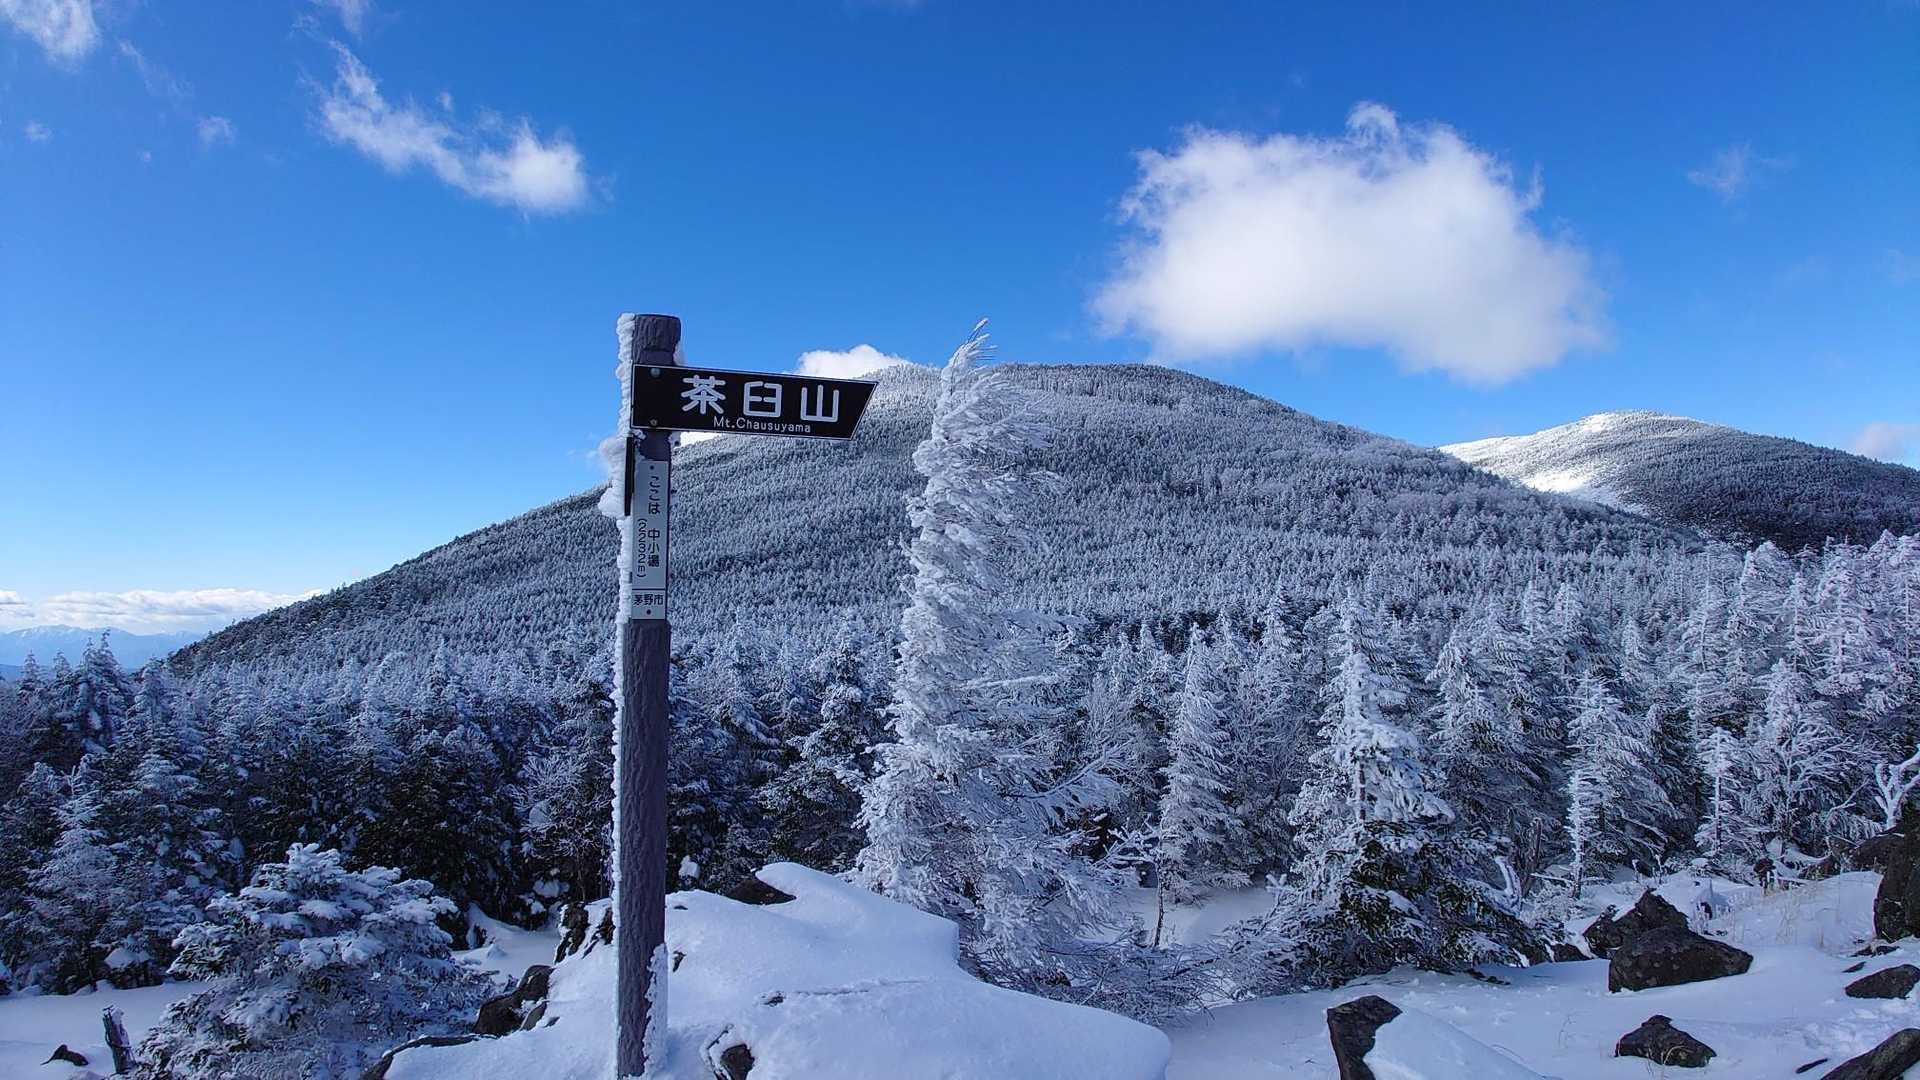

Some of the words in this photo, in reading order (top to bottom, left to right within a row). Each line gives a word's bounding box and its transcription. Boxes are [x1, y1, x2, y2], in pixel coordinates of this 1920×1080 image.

[681, 375, 839, 422] 茶臼山
[713, 416, 811, 433] Mt.Chausuyama
[648, 476, 660, 514] ここは
[634, 594, 663, 606] 茅野市
